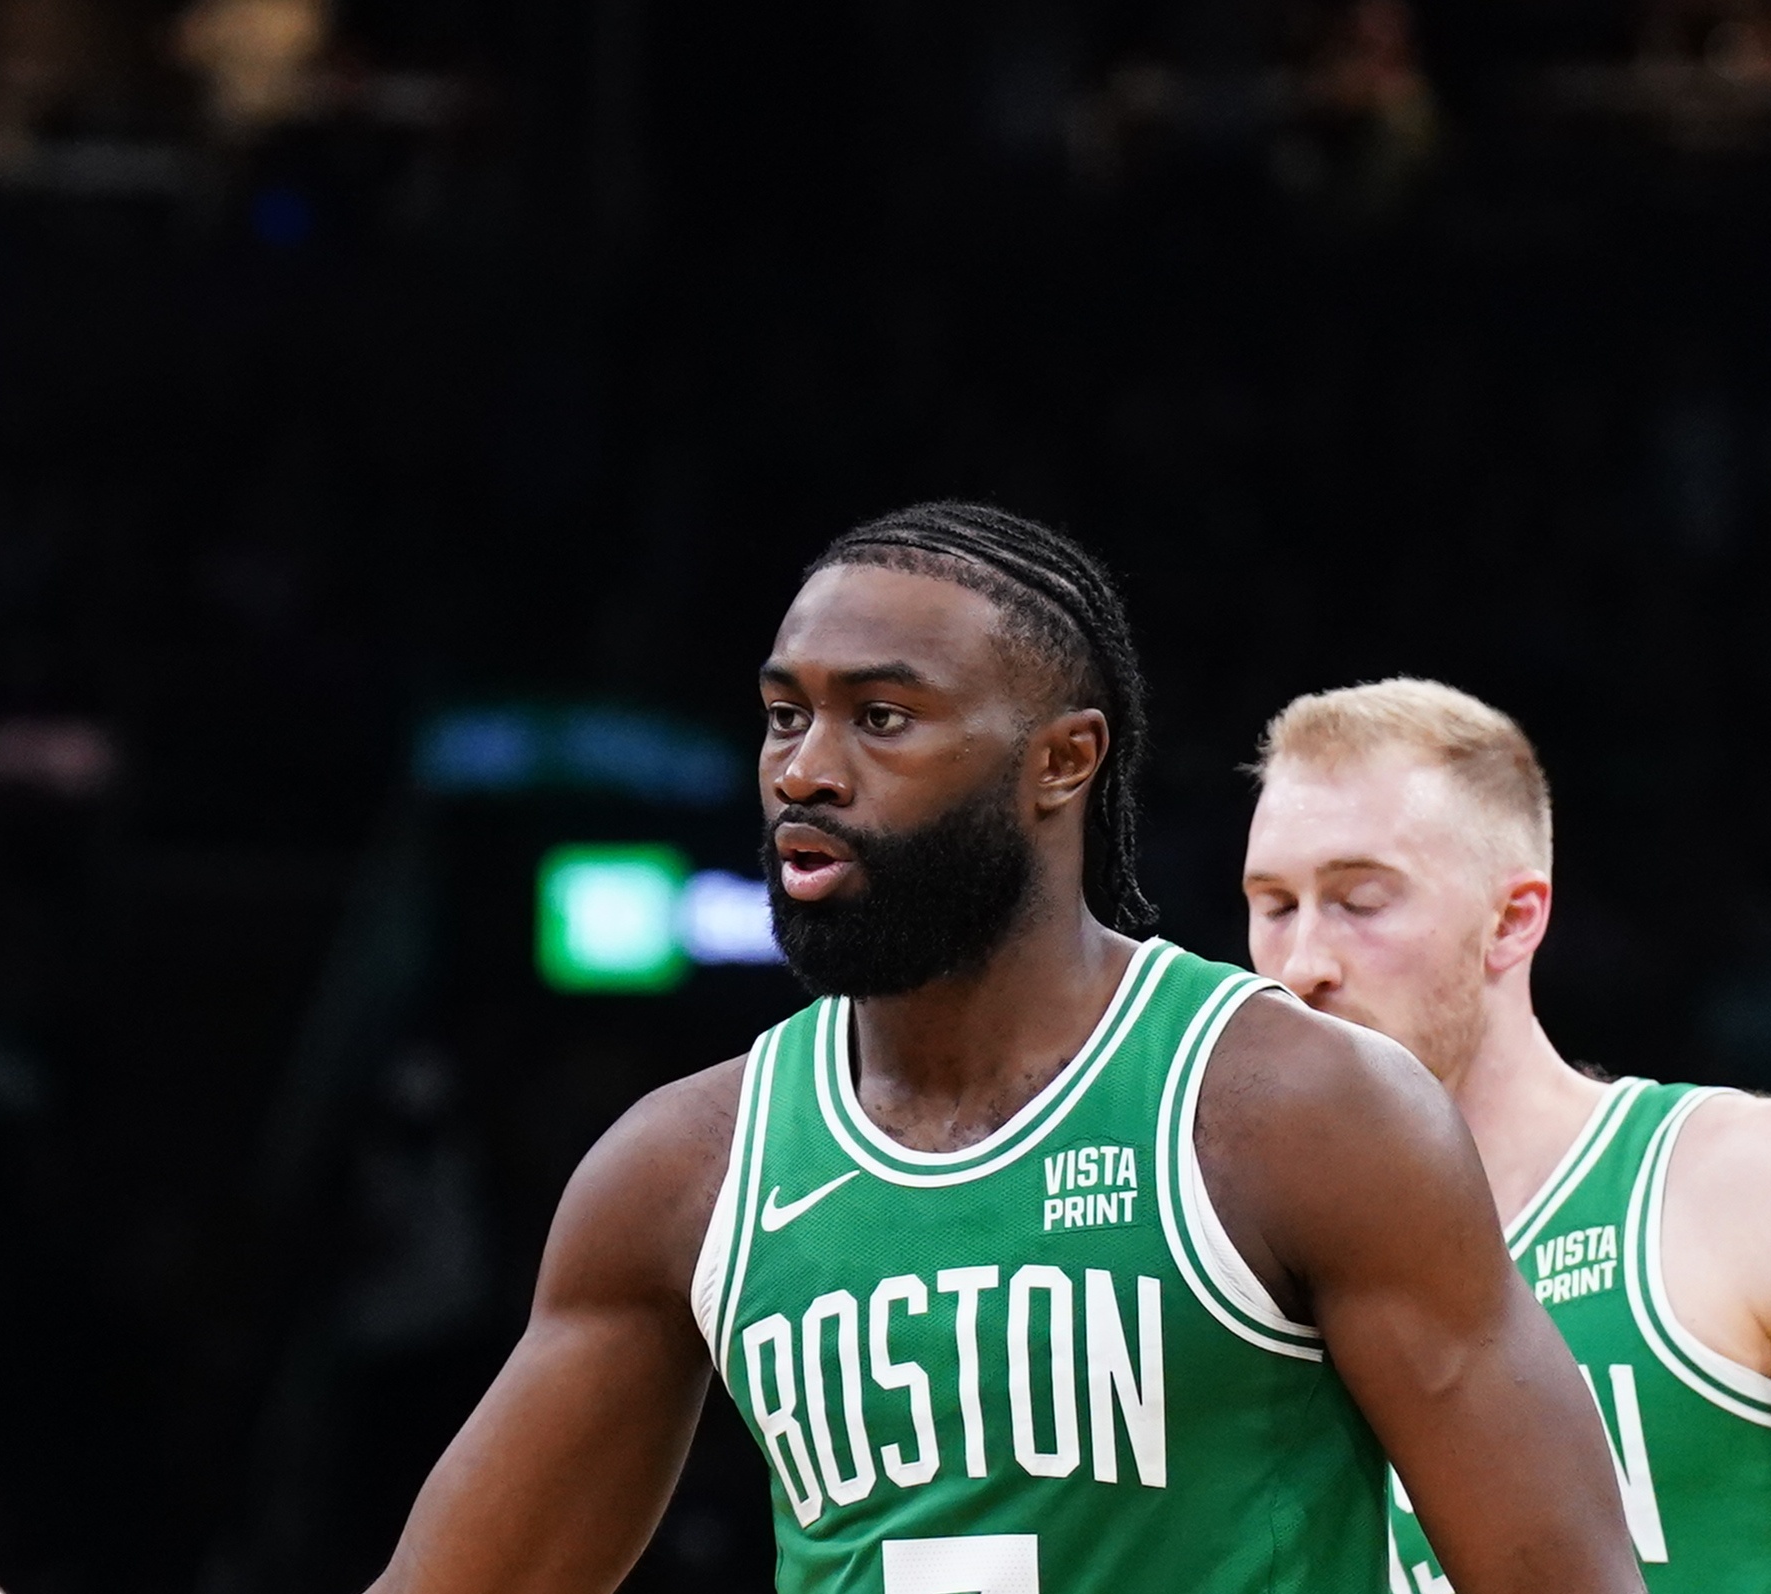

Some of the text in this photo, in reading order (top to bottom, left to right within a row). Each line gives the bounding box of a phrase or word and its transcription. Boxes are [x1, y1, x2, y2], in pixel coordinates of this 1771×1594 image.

[1044, 1146, 1138, 1196] VISTA
[1044, 1190, 1138, 1231] PRINT
[1535, 1225, 1618, 1279] VISTA
[1534, 1260, 1618, 1305] PRINT
[741, 1264, 1167, 1529] BOSTON
